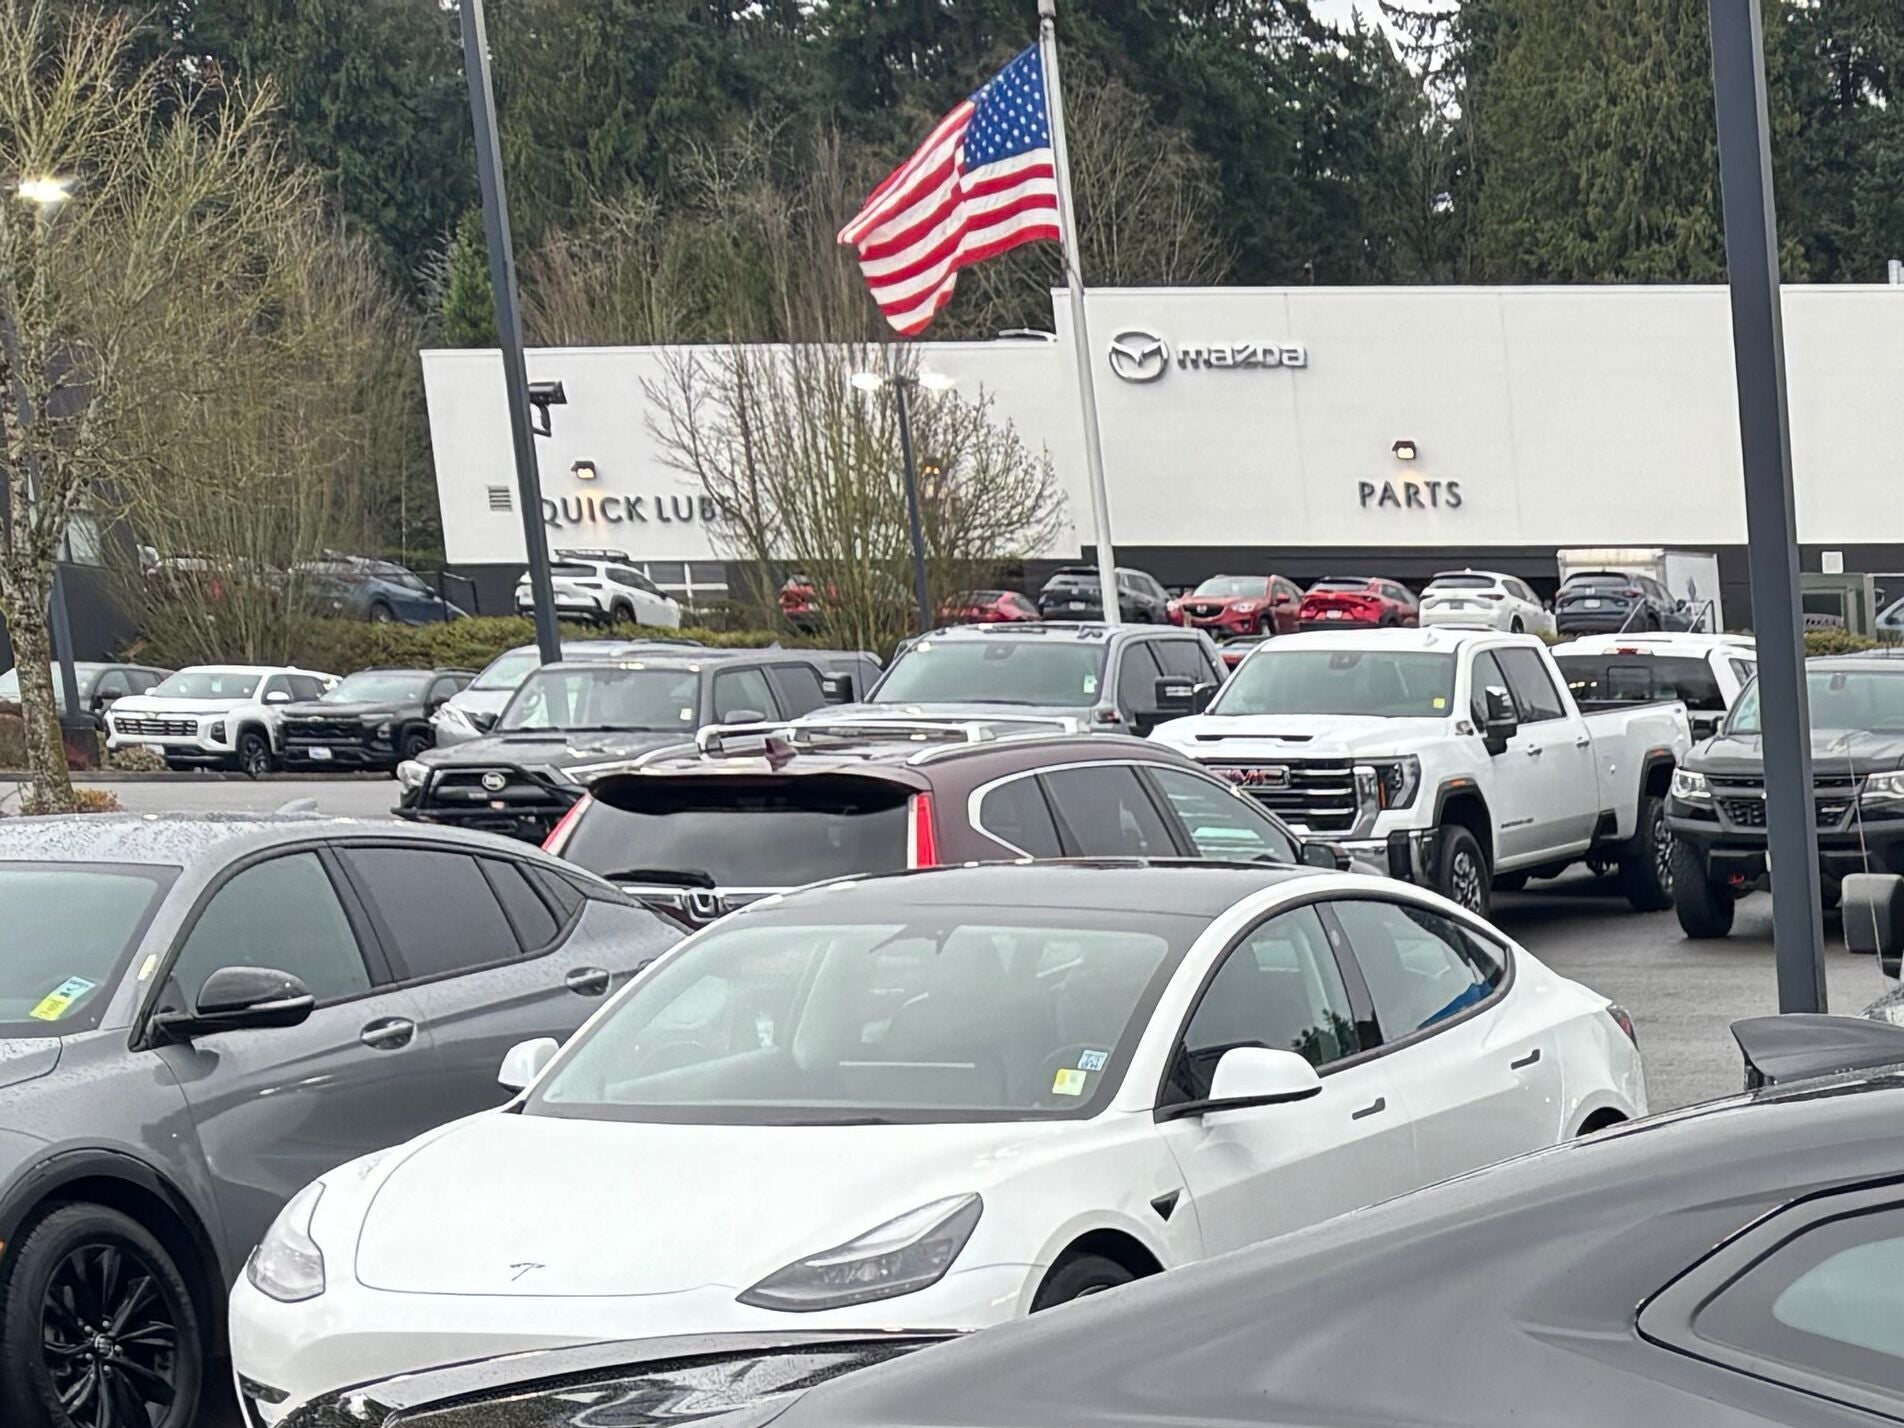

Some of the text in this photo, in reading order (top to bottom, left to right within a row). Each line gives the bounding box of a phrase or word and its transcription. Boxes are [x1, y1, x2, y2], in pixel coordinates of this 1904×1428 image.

[1177, 343, 1308, 369] mazda
[1358, 480, 1463, 508] PARTS
[541, 496, 648, 528] QUICK
